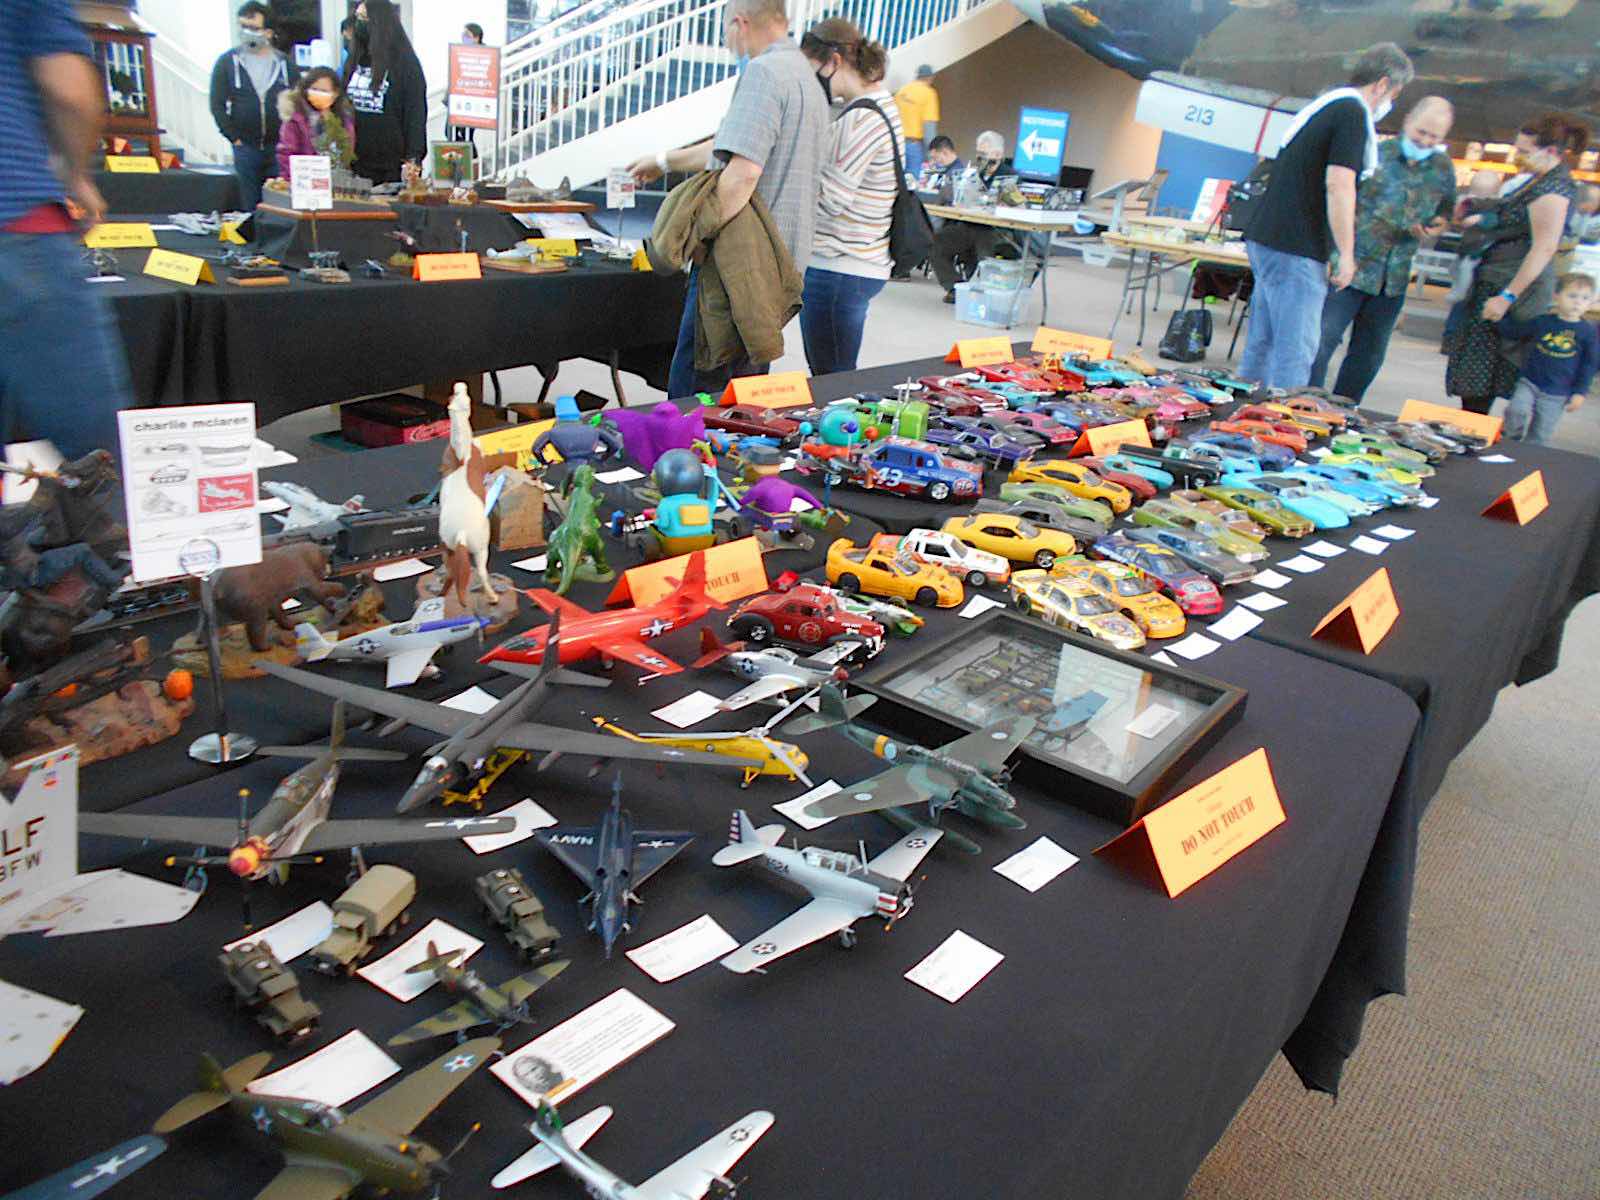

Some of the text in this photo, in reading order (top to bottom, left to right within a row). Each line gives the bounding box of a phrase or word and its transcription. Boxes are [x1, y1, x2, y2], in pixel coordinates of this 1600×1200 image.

[1184, 104, 1215, 126] 213
[134, 420, 187, 432] charlie
[877, 467, 903, 487] 43
[1, 815, 45, 856] LF
[1181, 835, 1198, 855] DO
[1198, 820, 1220, 842] NOT
[1221, 796, 1255, 828] TOUCH
[549, 834, 593, 845] NAVY
